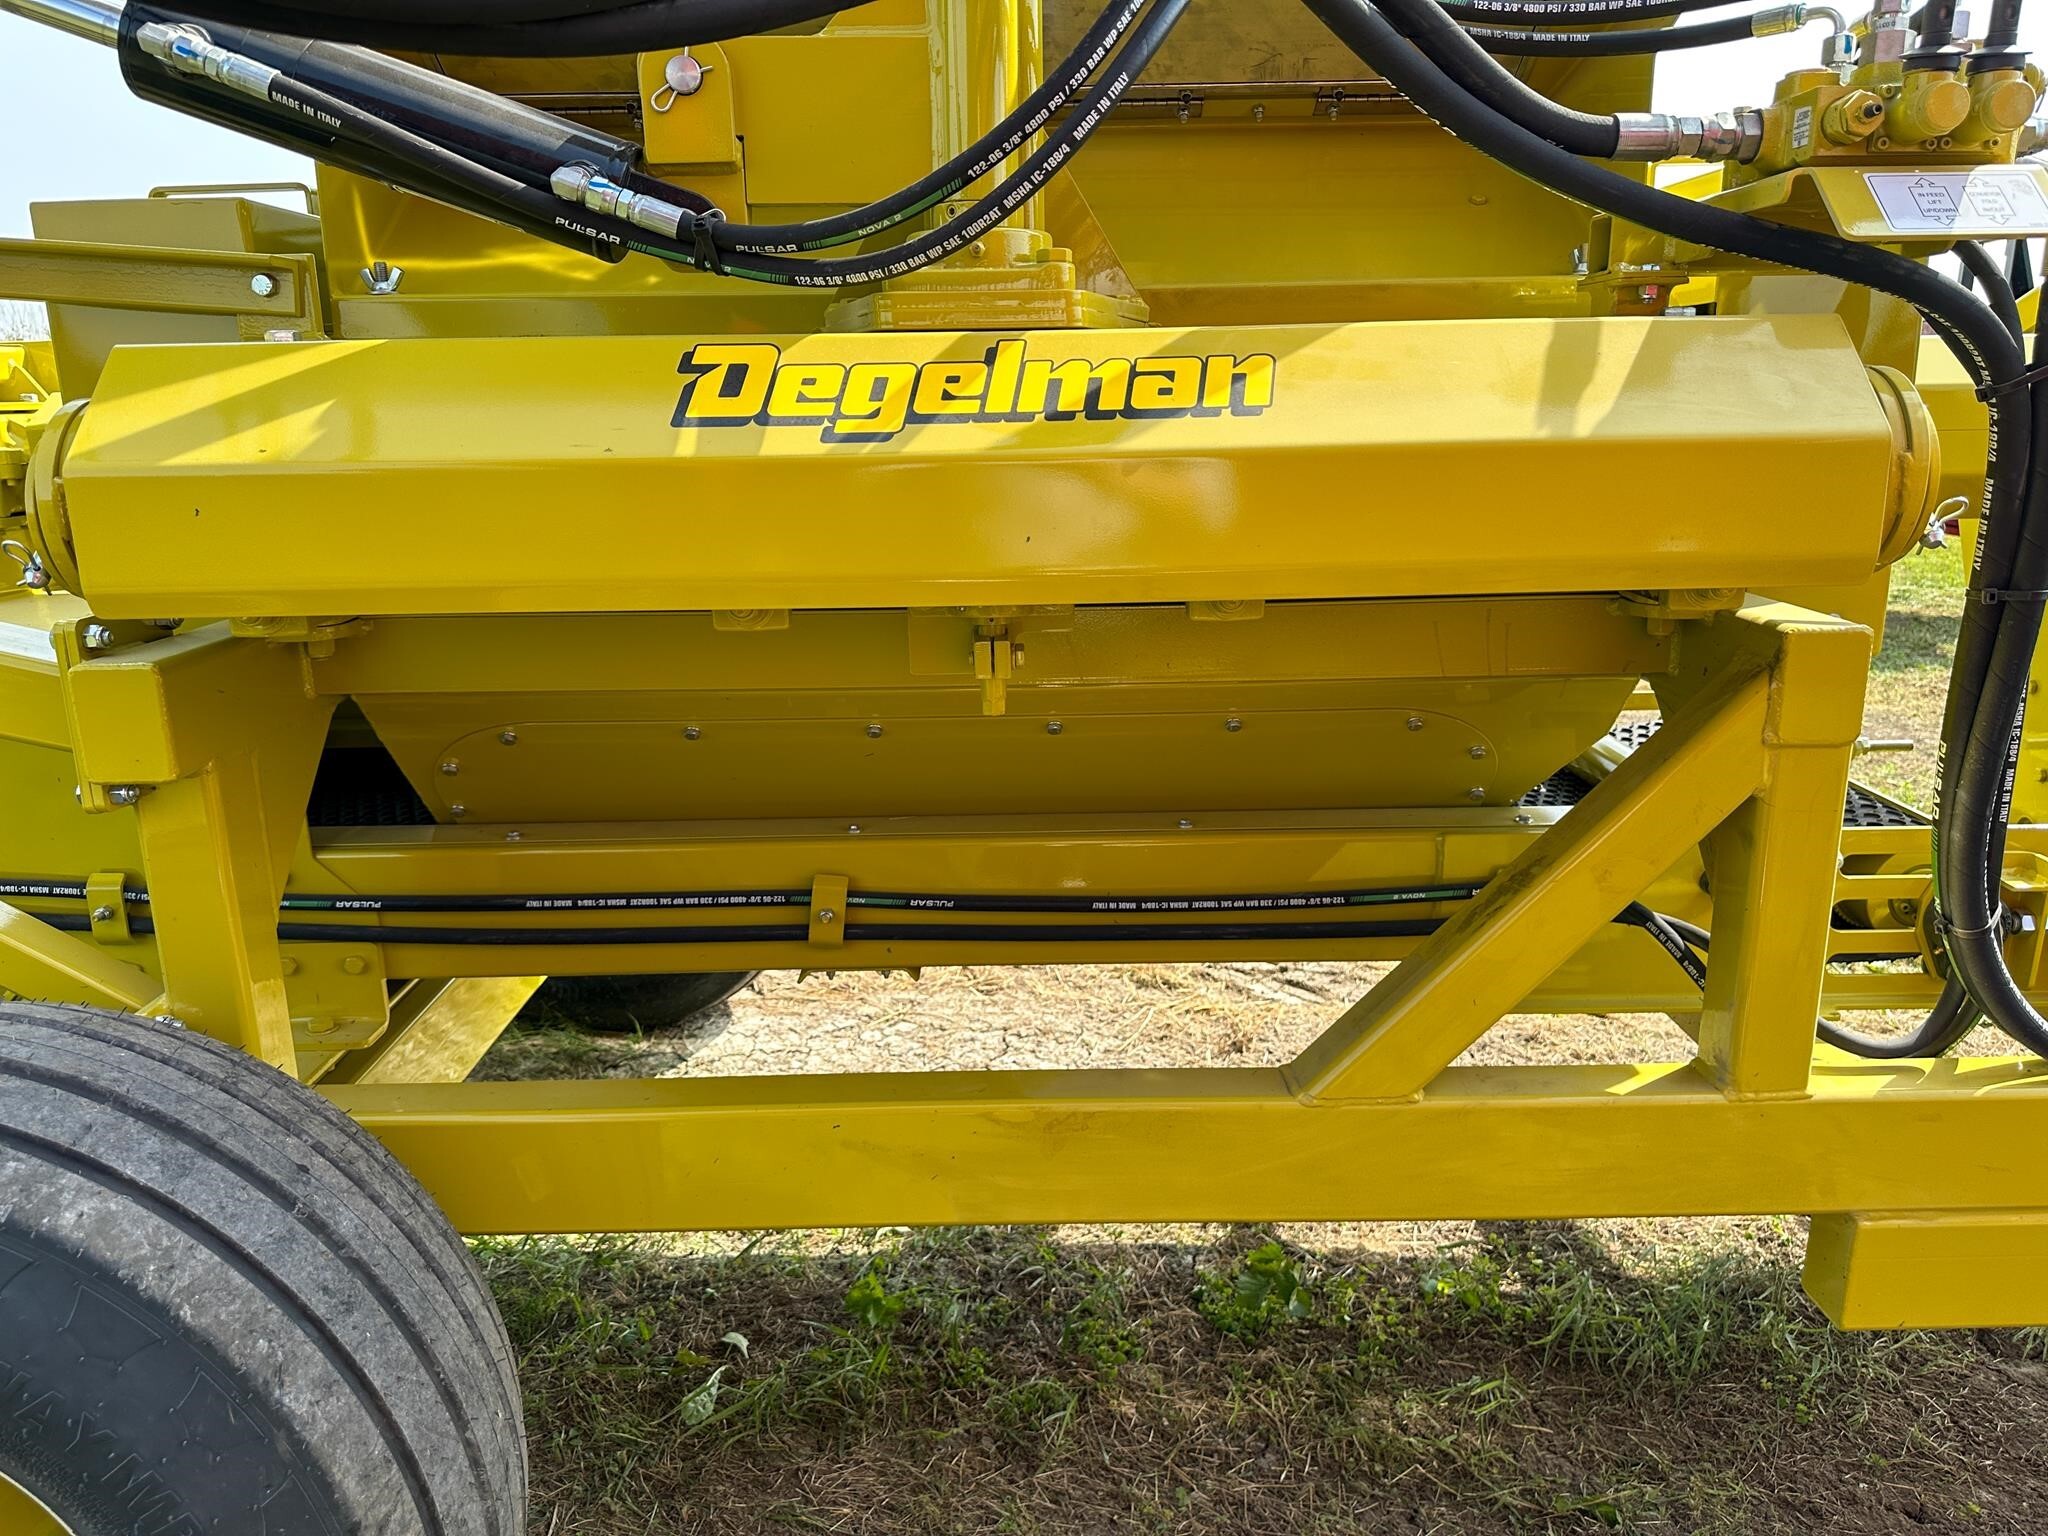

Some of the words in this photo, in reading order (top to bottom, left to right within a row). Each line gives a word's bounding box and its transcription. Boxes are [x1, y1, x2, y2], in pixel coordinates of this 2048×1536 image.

[1473, 0, 1502, 11] 122-06
[1523, 4, 1546, 13] 4800
[1547, 4, 1561, 13] PSI
[1569, 3, 1586, 12] 330
[1588, 1, 1607, 11] BAR
[1609, 0, 1623, 10] WP
[1625, 0, 1642, 8] SAE
[1532, 32, 1557, 42] MADE
[1558, 33, 1568, 42] IN
[1569, 33, 1591, 42] ITALY
[271, 91, 301, 111] MADE
[302, 104, 315, 118] IN
[317, 110, 342, 128] ITALY
[735, 244, 799, 254] PULSAR
[857, 219, 892, 237] NOVA
[967, 148, 1004, 179] 122-06
[1024, 108, 1049, 134] 4800
[1049, 92, 1066, 112] PSI
[1069, 68, 1088, 90] 330
[1086, 46, 1106, 71] BAR
[1103, 28, 1119, 52] WP
[1116, 10, 1133, 33] SAE
[554, 216, 622, 245] PULSAR
[794, 275, 826, 287] 122-06
[846, 273, 869, 285] 4800
[869, 270, 885, 281] PSI
[889, 261, 908, 275] 330
[908, 252, 928, 269] BAR
[927, 246, 944, 261] WP
[943, 235, 963, 251] SAE
[961, 206, 1003, 247] 100R2AT
[1002, 179, 1034, 211] MSHA
[1030, 143, 1071, 185] IC-188/4
[1072, 111, 1102, 141] MADE
[1096, 97, 1112, 114] IN
[1107, 71, 1131, 104] ITALY
[671, 339, 1276, 444] Degelman
[1980, 477, 1995, 517] MADE
[1977, 514, 1990, 535] IN
[1971, 534, 1987, 571] ITALY
[1931, 740, 1948, 821] PULSAR
[2003, 768, 2016, 793] MADE
[2001, 791, 2013, 805] IN
[336, 900, 382, 908] PULSAR
[525, 900, 542, 908] ITALY
[552, 899, 572, 907] MADE
[660, 897, 672, 906] SAE
[672, 897, 684, 905] WP
[684, 897, 699, 905] BAR
[717, 896, 729, 904] PSI
[910, 899, 954, 907] PULSAR
[1191, 900, 1219, 908] 100R2AT
[1220, 900, 1232, 908] SAE
[1233, 899, 1245, 907] WP
[1092, 902, 1109, 910] ITALY
[1645, 921, 1660, 936] ITALY
[1659, 933, 1668, 943] IN
[1665, 941, 1683, 959] MADE
